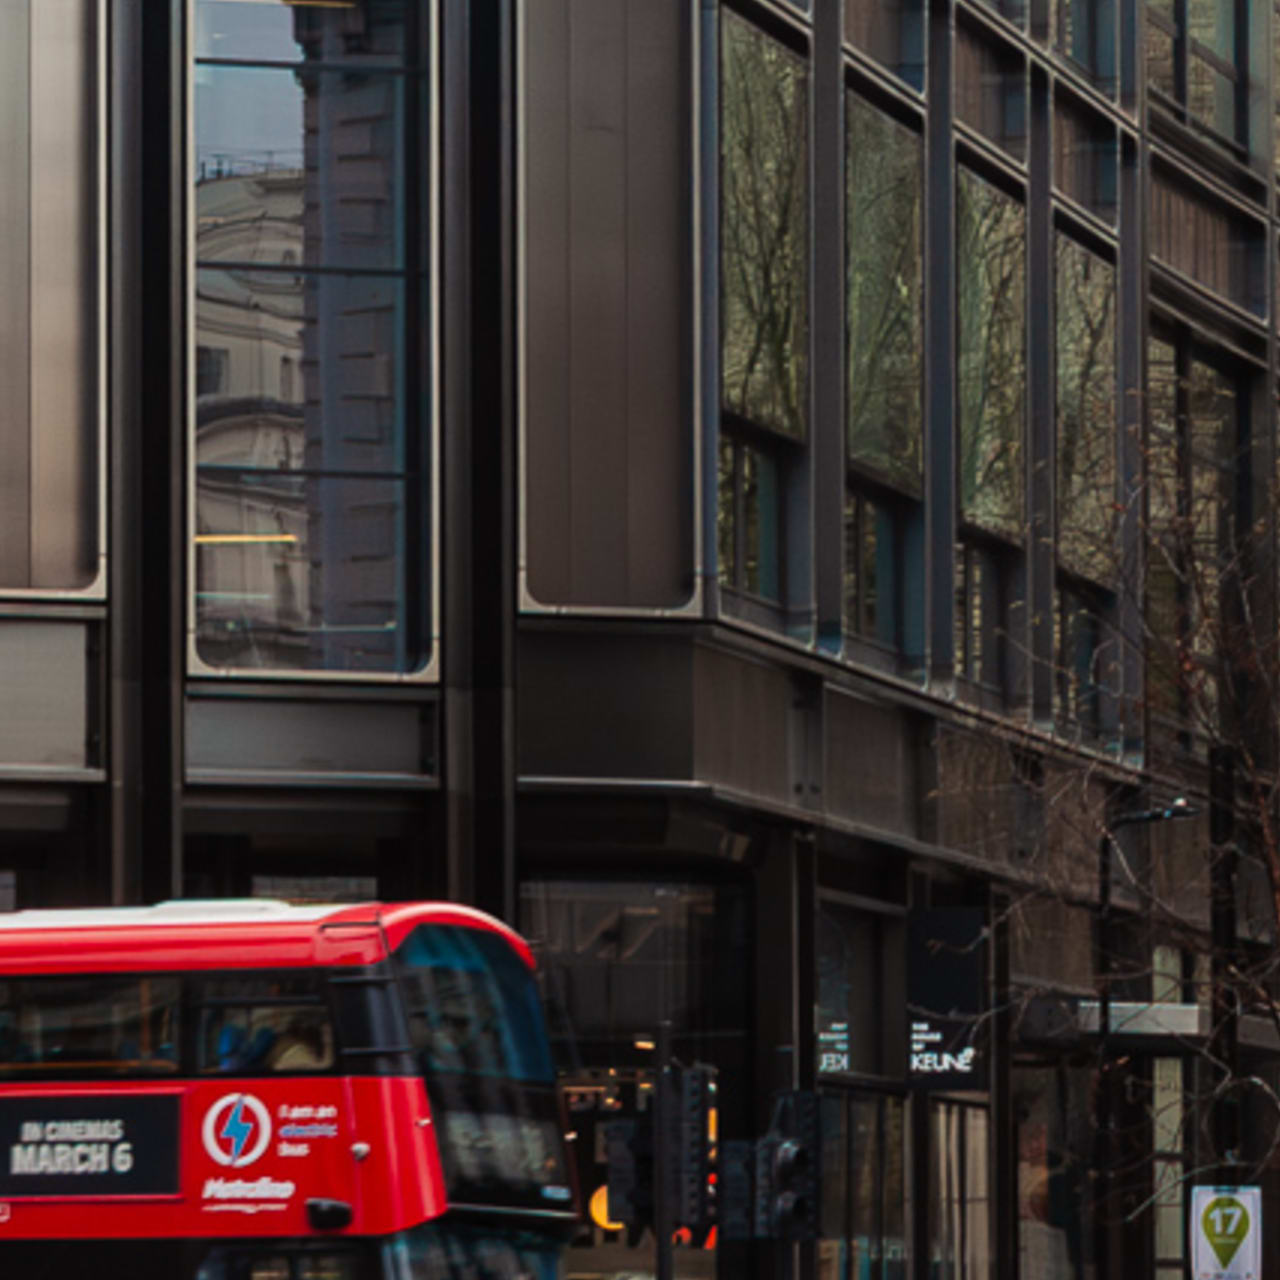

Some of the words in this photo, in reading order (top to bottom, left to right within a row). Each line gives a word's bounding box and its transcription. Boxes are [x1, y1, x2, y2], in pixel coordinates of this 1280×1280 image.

[46, 1119, 124, 1143] CINEMAS
[10, 1143, 109, 1175] MARCH
[112, 1142, 133, 1173] 6
[201, 1176, 296, 1200] Metroline
[1208, 1208, 1243, 1235] 17
